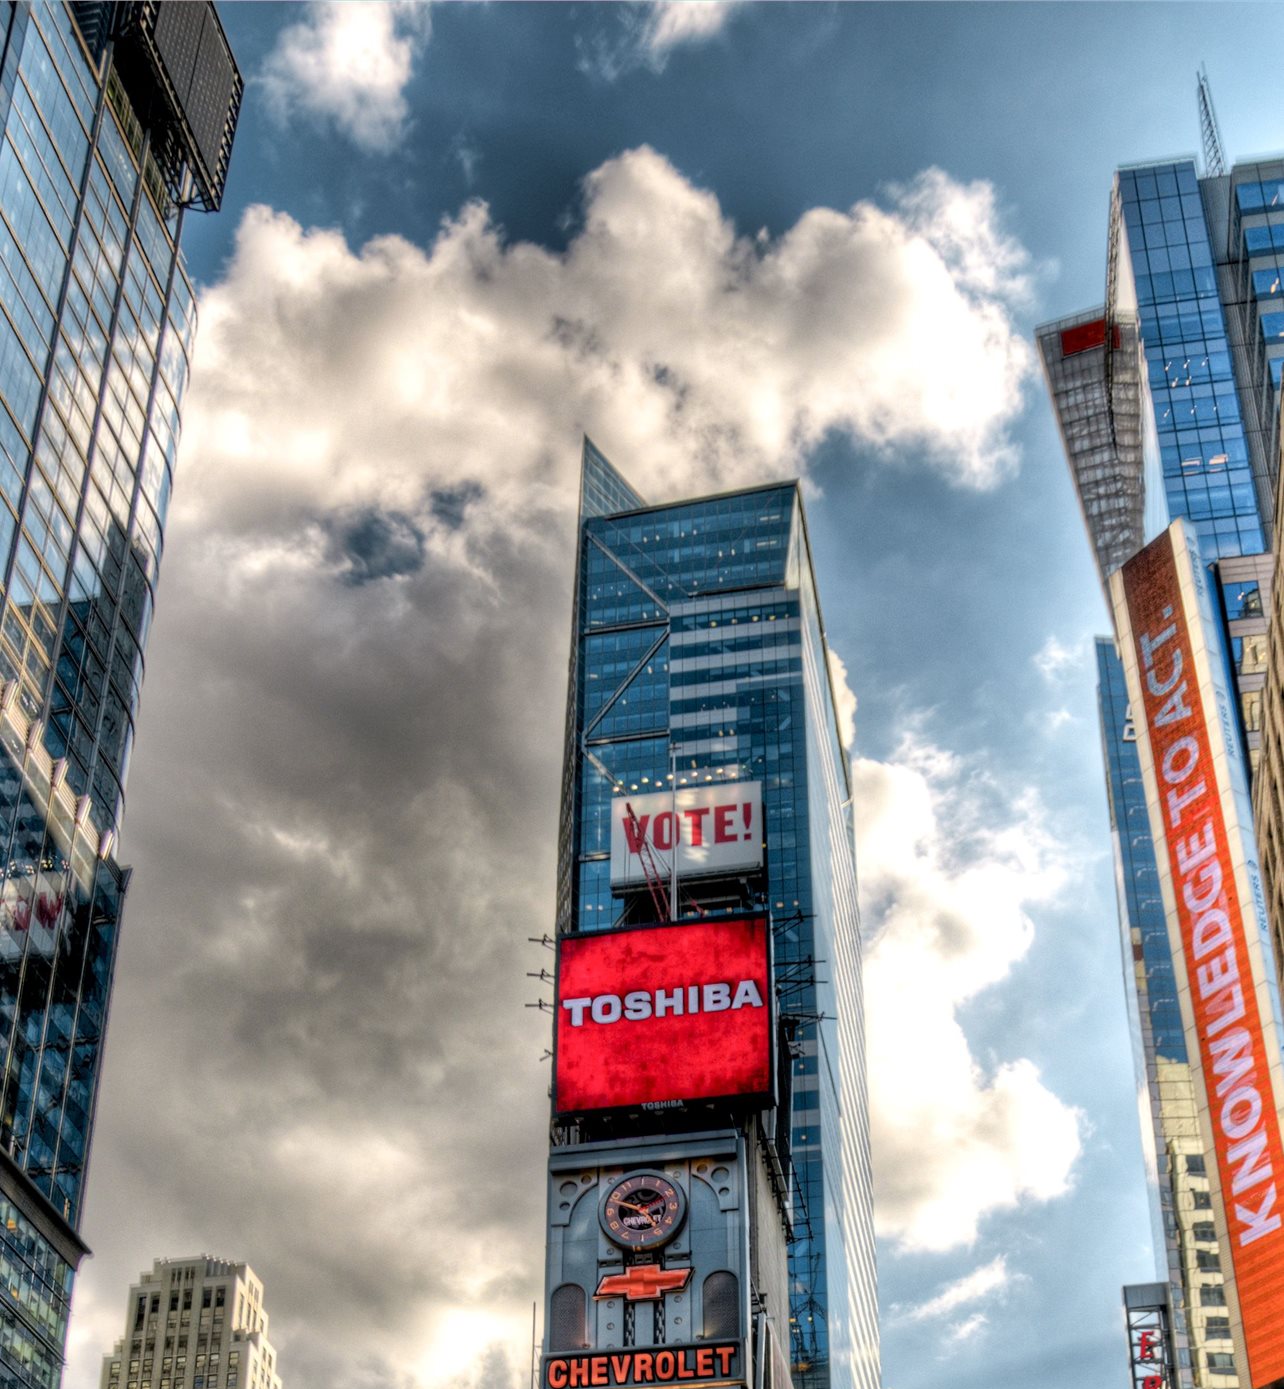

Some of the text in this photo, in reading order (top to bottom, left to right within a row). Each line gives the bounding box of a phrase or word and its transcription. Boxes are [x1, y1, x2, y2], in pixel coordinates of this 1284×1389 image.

[1217, 702, 1236, 759] REUTERS
[622, 802, 753, 855] VOTE!
[1142, 602, 1284, 1249] KNOWLEDGE TO ACT.
[562, 979, 764, 1028] TOSHIBA
[641, 1098, 684, 1111] TOSHIBA
[548, 1346, 736, 1389] CHEVROLET
